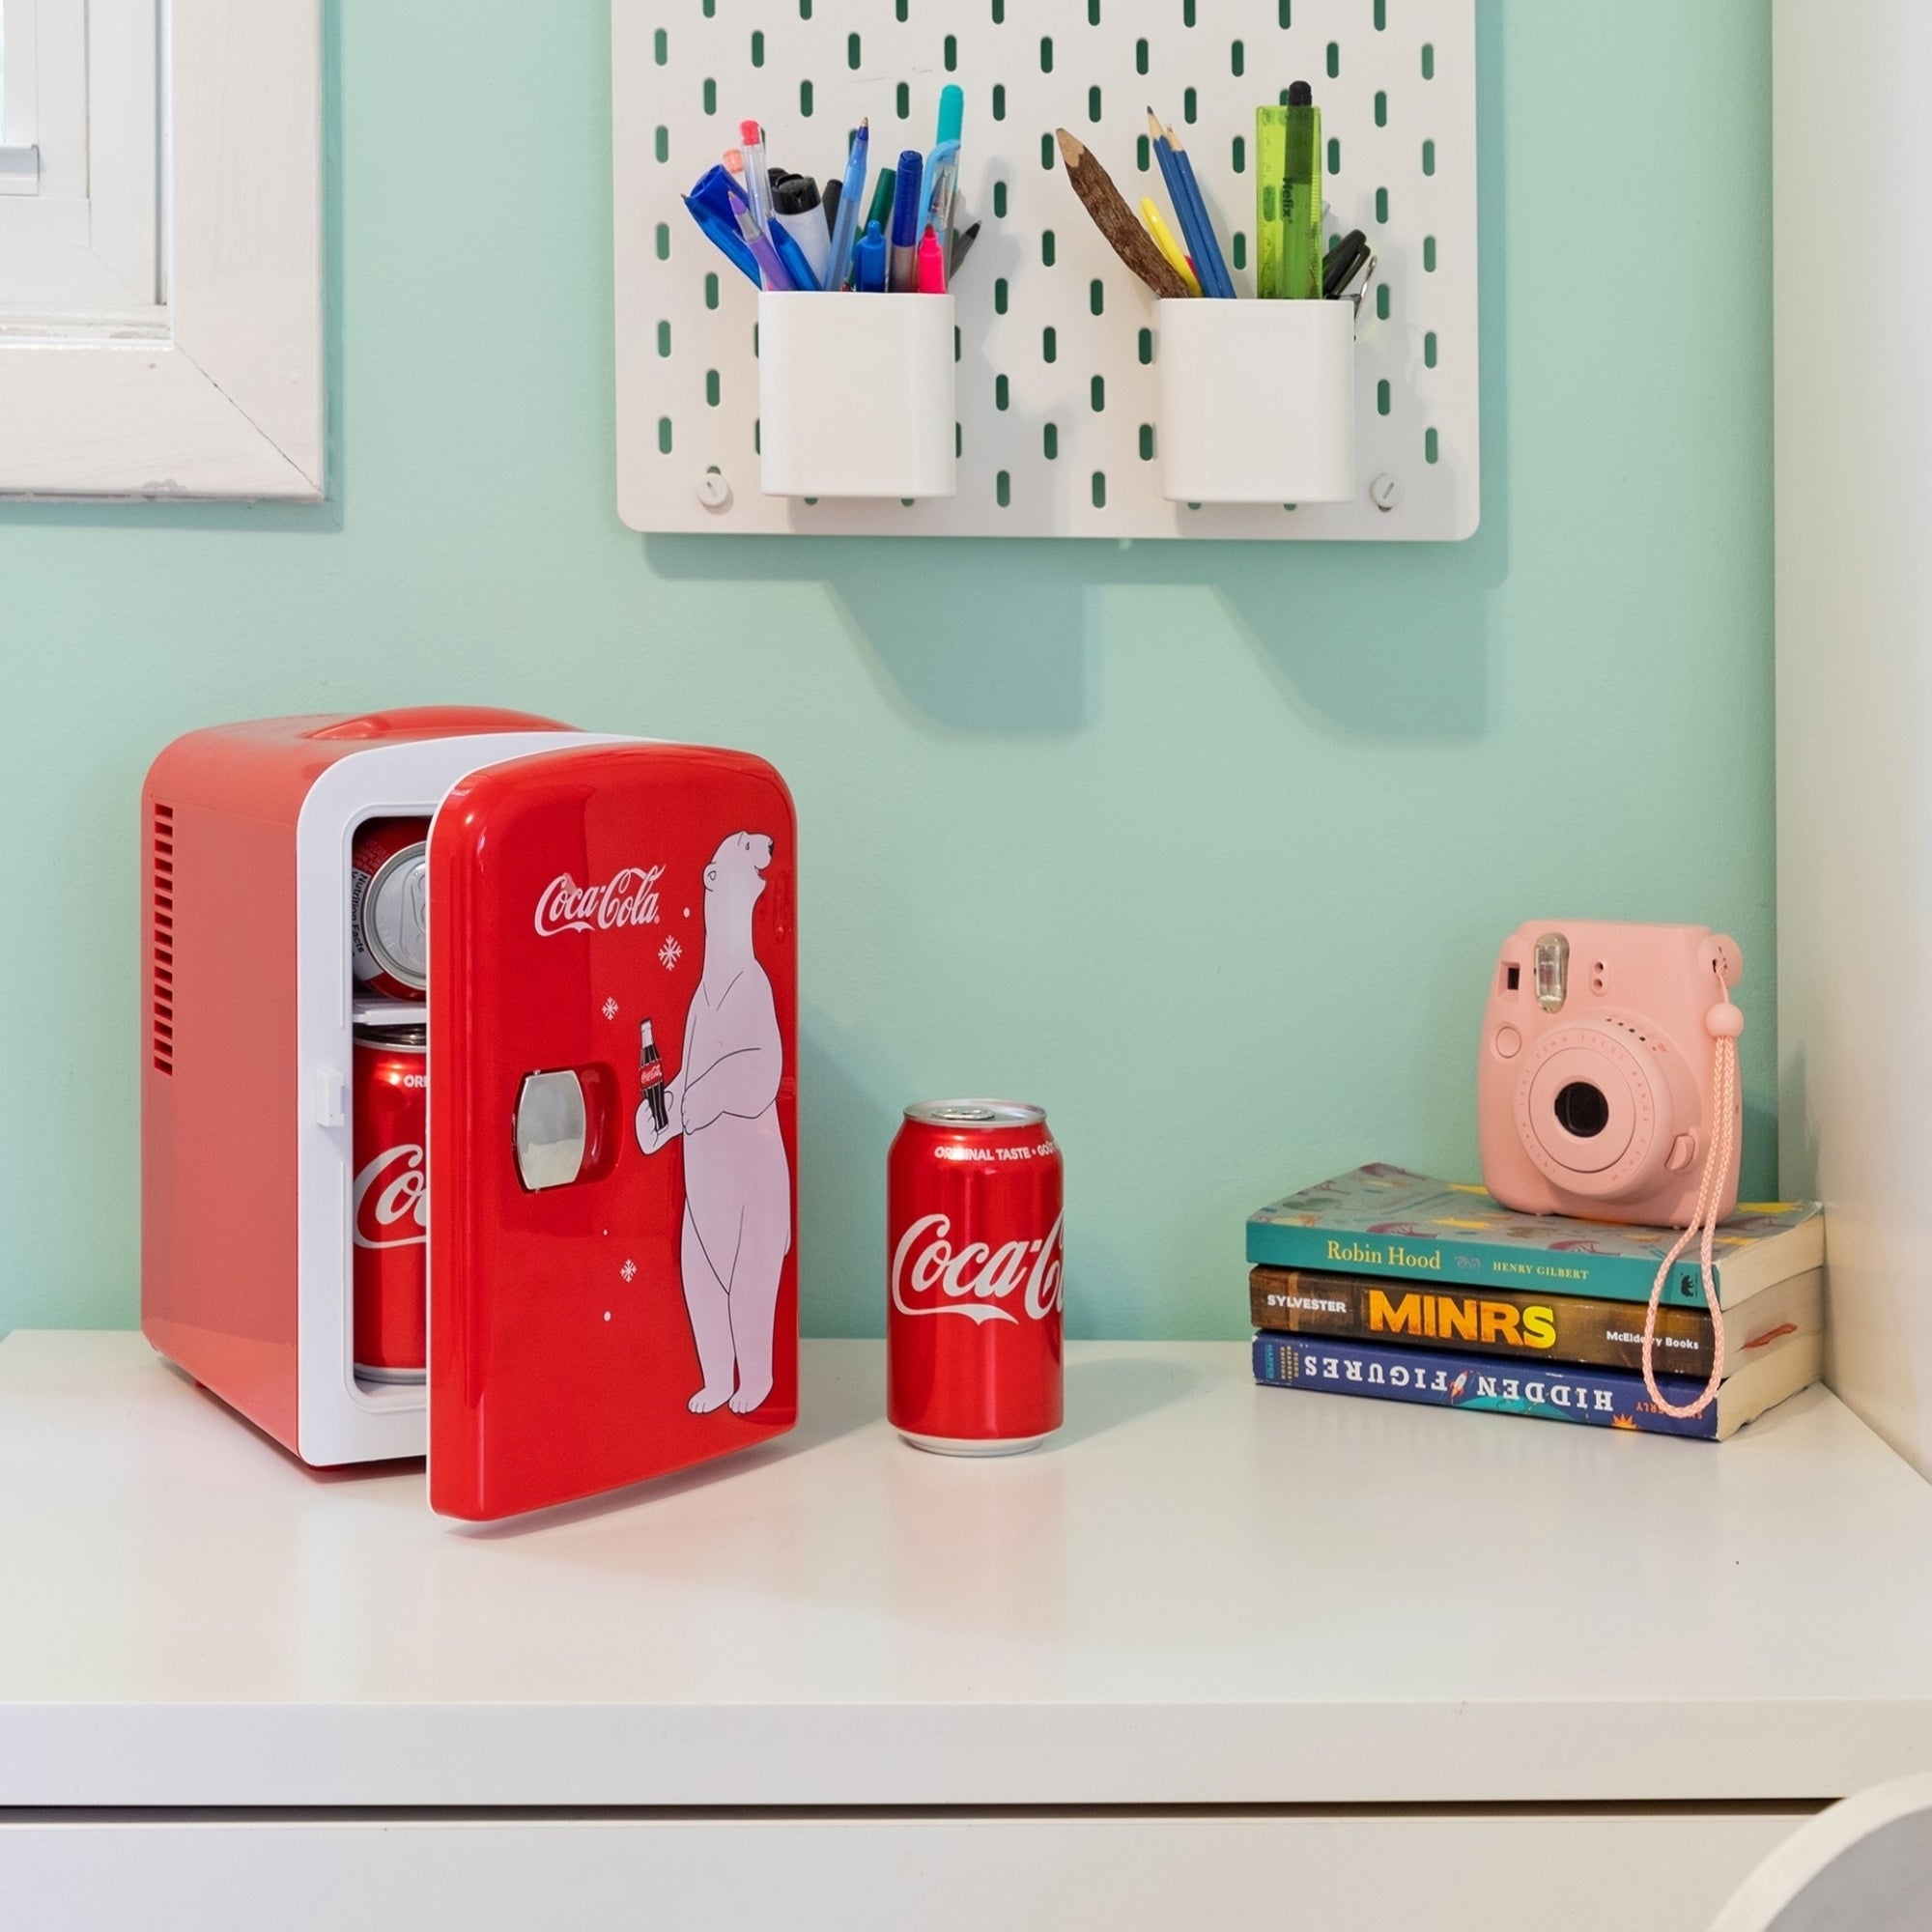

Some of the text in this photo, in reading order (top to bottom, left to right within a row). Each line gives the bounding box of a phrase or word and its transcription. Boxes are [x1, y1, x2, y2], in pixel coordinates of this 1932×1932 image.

[534, 864, 667, 937] Coca-Cola
[996, 1147, 1032, 1162] TASTE
[1325, 1240, 1442, 1271] Robin Hood
[1492, 1261, 1590, 1282] HENRY GILBERT
[1266, 1293, 1348, 1313] SYLVESTER
[1368, 1290, 1557, 1350] MINRS
[1605, 1330, 1700, 1350] McEldey Books
[1304, 1356, 1613, 1412] HIDDEN FIGURES
